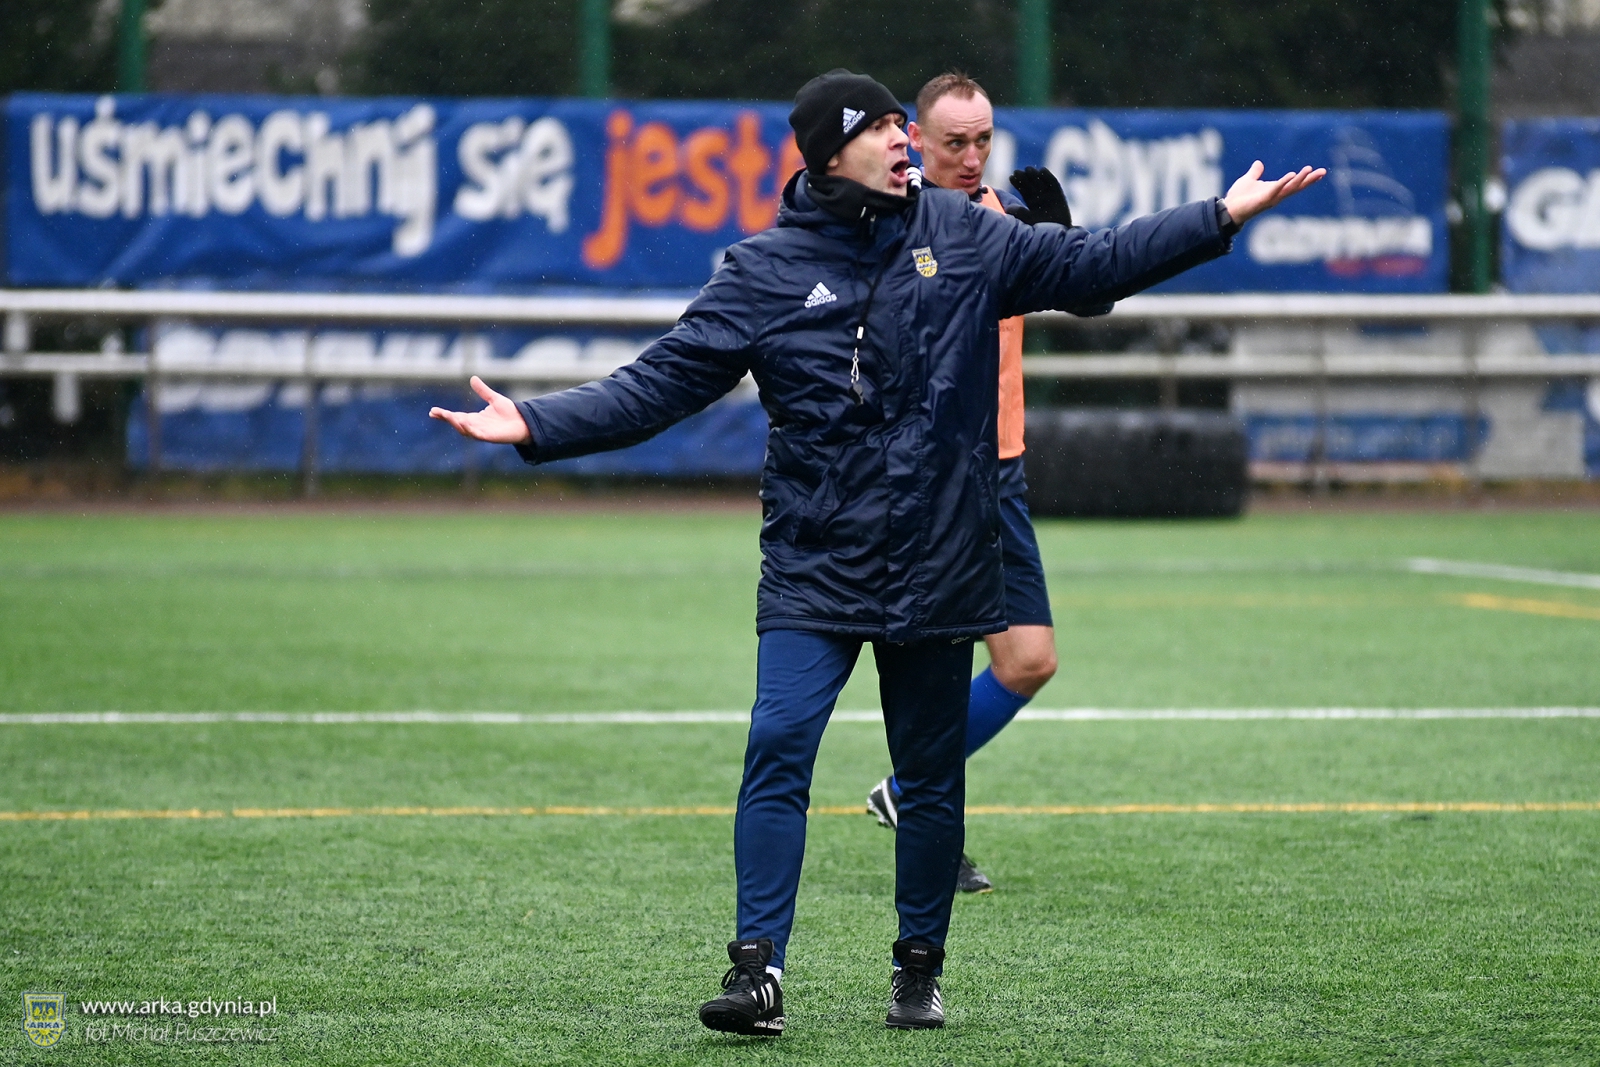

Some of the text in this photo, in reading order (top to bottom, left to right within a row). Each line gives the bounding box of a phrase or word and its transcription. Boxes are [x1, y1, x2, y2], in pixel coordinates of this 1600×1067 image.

[843, 109, 866, 134] adidas
[455, 117, 573, 233] się
[583, 109, 807, 267] jest
[804, 293, 837, 308] adidas
